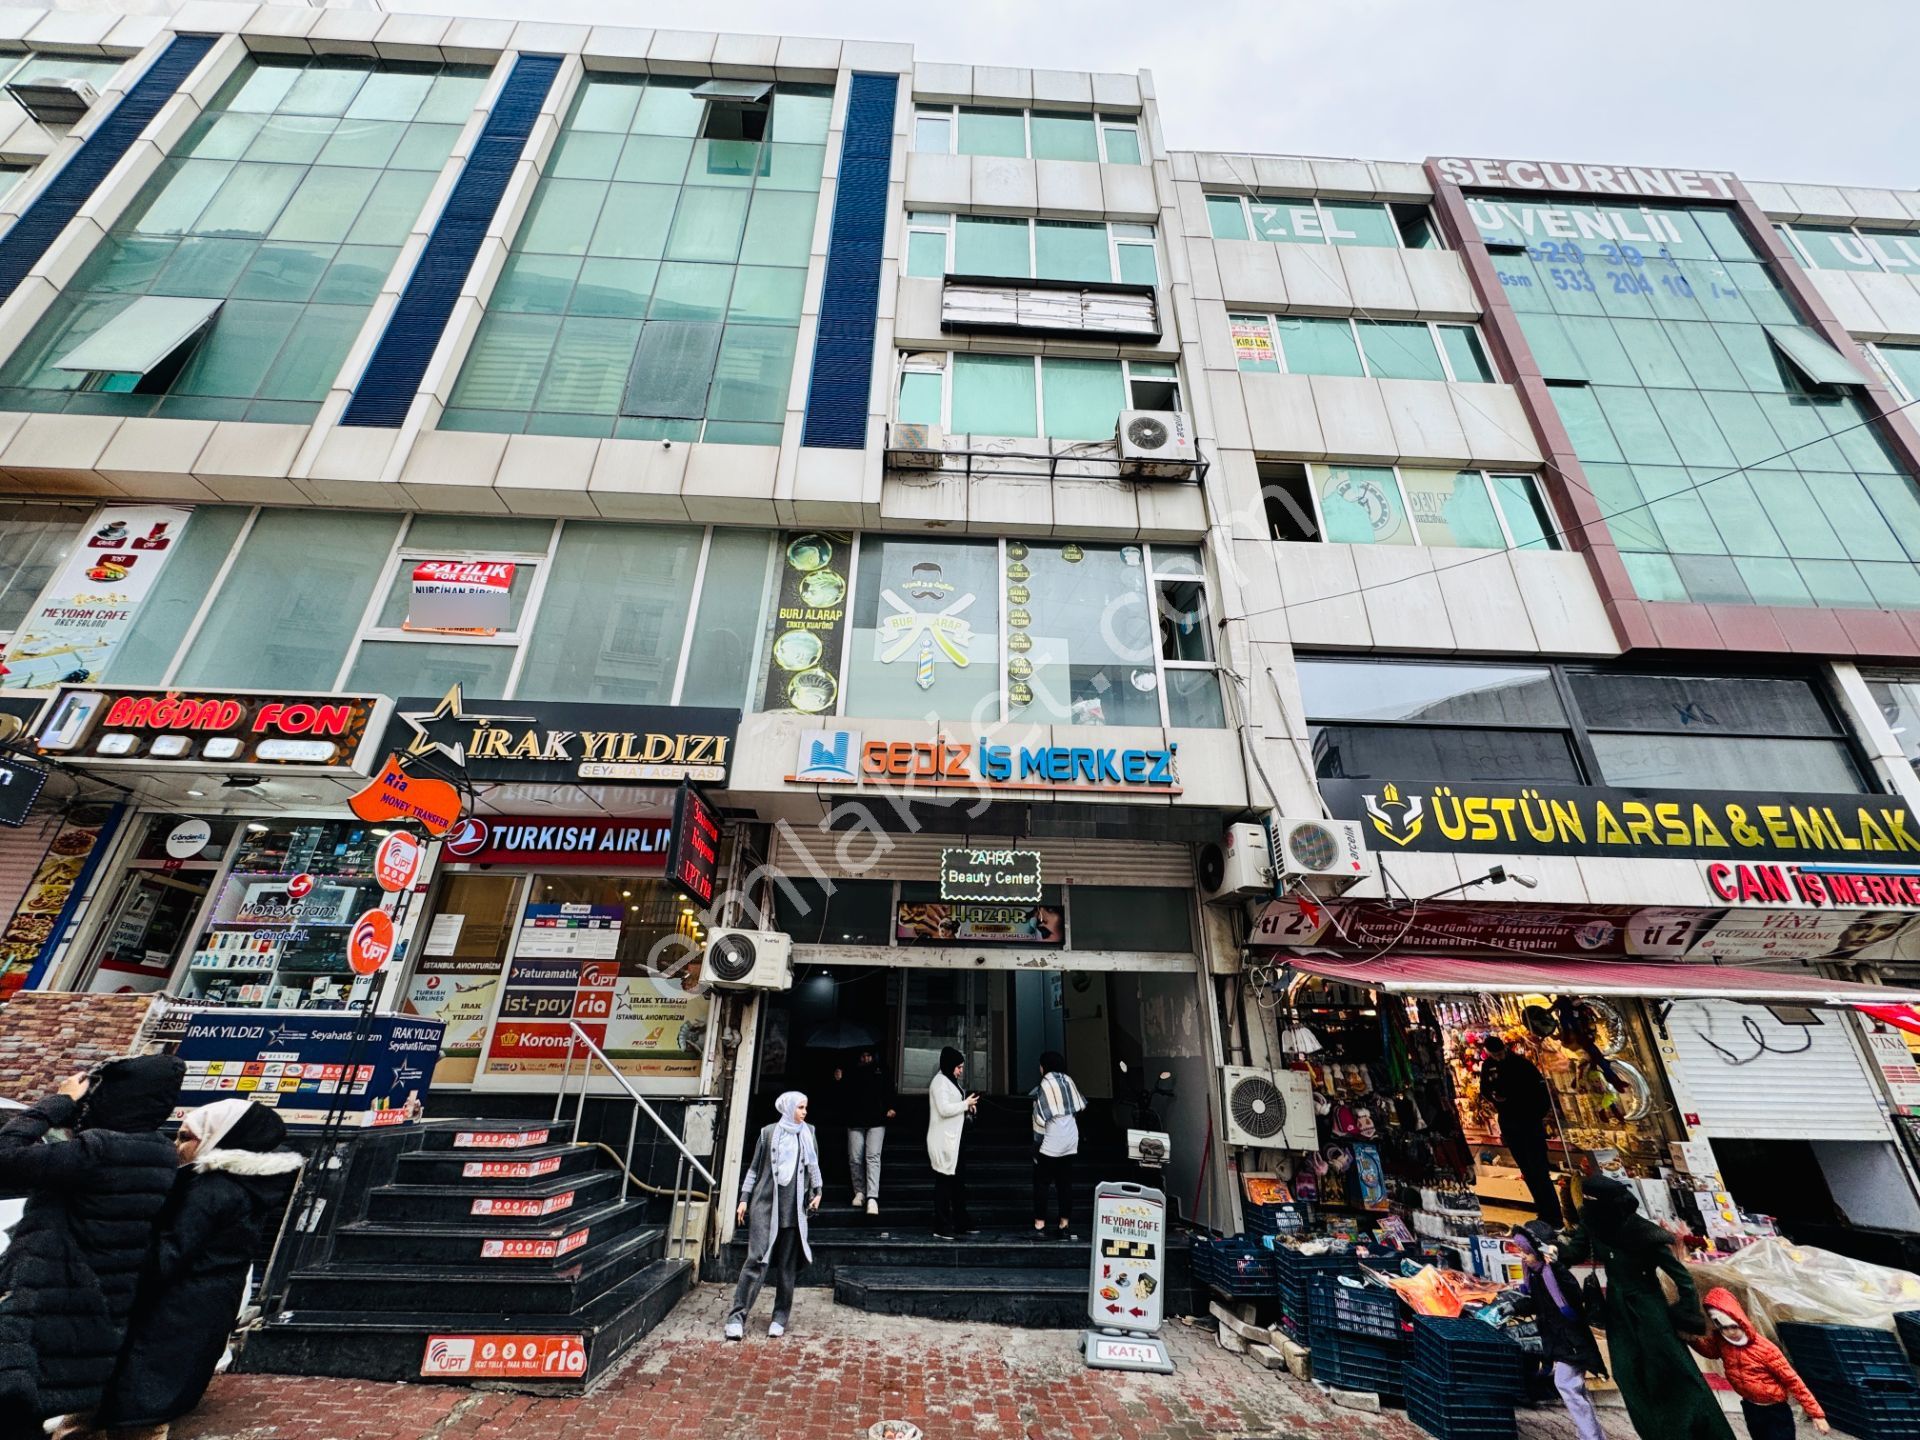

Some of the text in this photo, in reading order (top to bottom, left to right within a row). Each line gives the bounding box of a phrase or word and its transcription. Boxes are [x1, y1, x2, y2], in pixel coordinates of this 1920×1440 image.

[1551, 269, 1596, 292] 533
[1606, 271, 1654, 296] 204
[421, 562, 508, 579] SATILIK
[434, 572, 488, 583] FOR SALE
[41, 608, 131, 621] MEYDAN CAFE
[780, 608, 843, 621] BURJ ALARAP
[103, 691, 351, 735] BAĞDAD FON
[580, 731, 730, 766] YILDIZI
[862, 734, 972, 777] GEDİZ
[979, 736, 1012, 782] İŞ
[384, 772, 409, 792] Ria
[379, 792, 450, 829] MONEY TRANSFER
[1432, 785, 1920, 852] ÜSTÜN ARSA & EMLAK
[492, 826, 671, 853] TURKISH AIRLIN
[968, 850, 1015, 867] ZAHRA
[949, 869, 1036, 887] Beauty Center
[1707, 863, 1792, 902] CAN
[949, 904, 1027, 924] HAZAR
[253, 928, 311, 941] GönderAL
[362, 943, 387, 962] UPT
[591, 974, 616, 986] UPT
[504, 993, 607, 1016] ist-pay ria
[220, 1026, 265, 1040] YILDIZI
[413, 1028, 441, 1041] YILDIZI
[522, 1201, 538, 1214] ria
[1101, 1214, 1160, 1232] MEYDAN CAFE
[535, 1241, 552, 1255] ria
[439, 1340, 584, 1371] UPT ria
